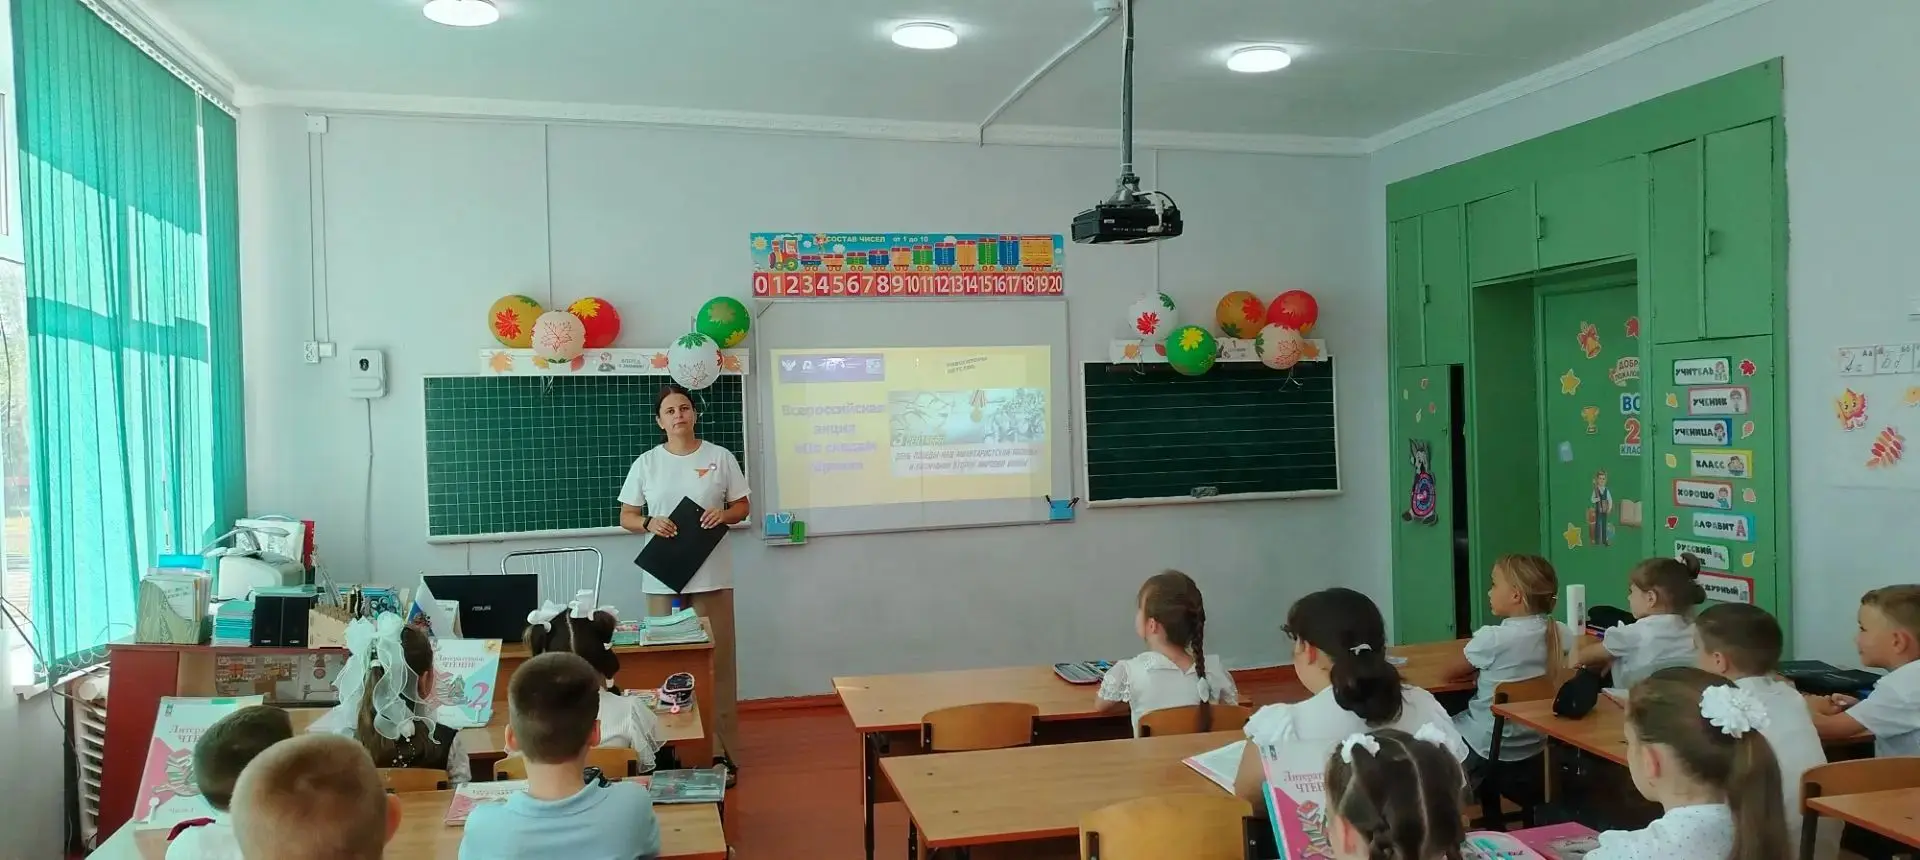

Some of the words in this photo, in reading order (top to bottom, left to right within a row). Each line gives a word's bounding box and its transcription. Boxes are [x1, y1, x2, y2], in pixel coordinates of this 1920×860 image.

[826, 235, 857, 243] СОСТАВ
[859, 235, 886, 243] ЧИСЕЛ
[755, 275, 768, 293] 0
[773, 275, 782, 293] 1
[786, 275, 799, 293] 2
[802, 275, 814, 293] 3
[816, 275, 829, 293] 4
[833, 275, 844, 293] 5
[847, 275, 860, 293] 6
[861, 275, 874, 293] 7
[876, 275, 889, 293] 8
[891, 275, 904, 293] 9
[905, 275, 920, 293] 10
[922, 275, 934, 293] 11
[935, 275, 949, 293] 12
[950, 275, 963, 293] 13
[964, 275, 978, 293] 14
[979, 275, 992, 293] 15
[993, 275, 1006, 293] 16
[1007, 275, 1020, 293] 17
[1021, 275, 1034, 293] 18
[1035, 275, 1049, 293] 19
[1049, 275, 1063, 293] 20
[1618, 359, 1640, 370] ДОБР
[1675, 367, 1714, 377] УЧИТЕЛЬ
[1692, 397, 1728, 407] УЧЕНИК
[782, 402, 885, 417] Всероссийская
[1625, 418, 1640, 444] 2
[1674, 428, 1714, 437] УЧЕНИЦА
[1621, 445, 1640, 454] КЛАС
[1695, 459, 1726, 469] КЛАСС
[1677, 488, 1715, 499] ХОРОШО
[1694, 520, 1735, 531] АЛФАВИТ
[1676, 542, 1713, 555] РУССКИЙ
[1704, 584, 1739, 597] ЖУРНЫЙ
[467, 681, 490, 709] 2
[1283, 770, 1324, 782] Литерат
[1295, 781, 1326, 793] ЧТЕН
